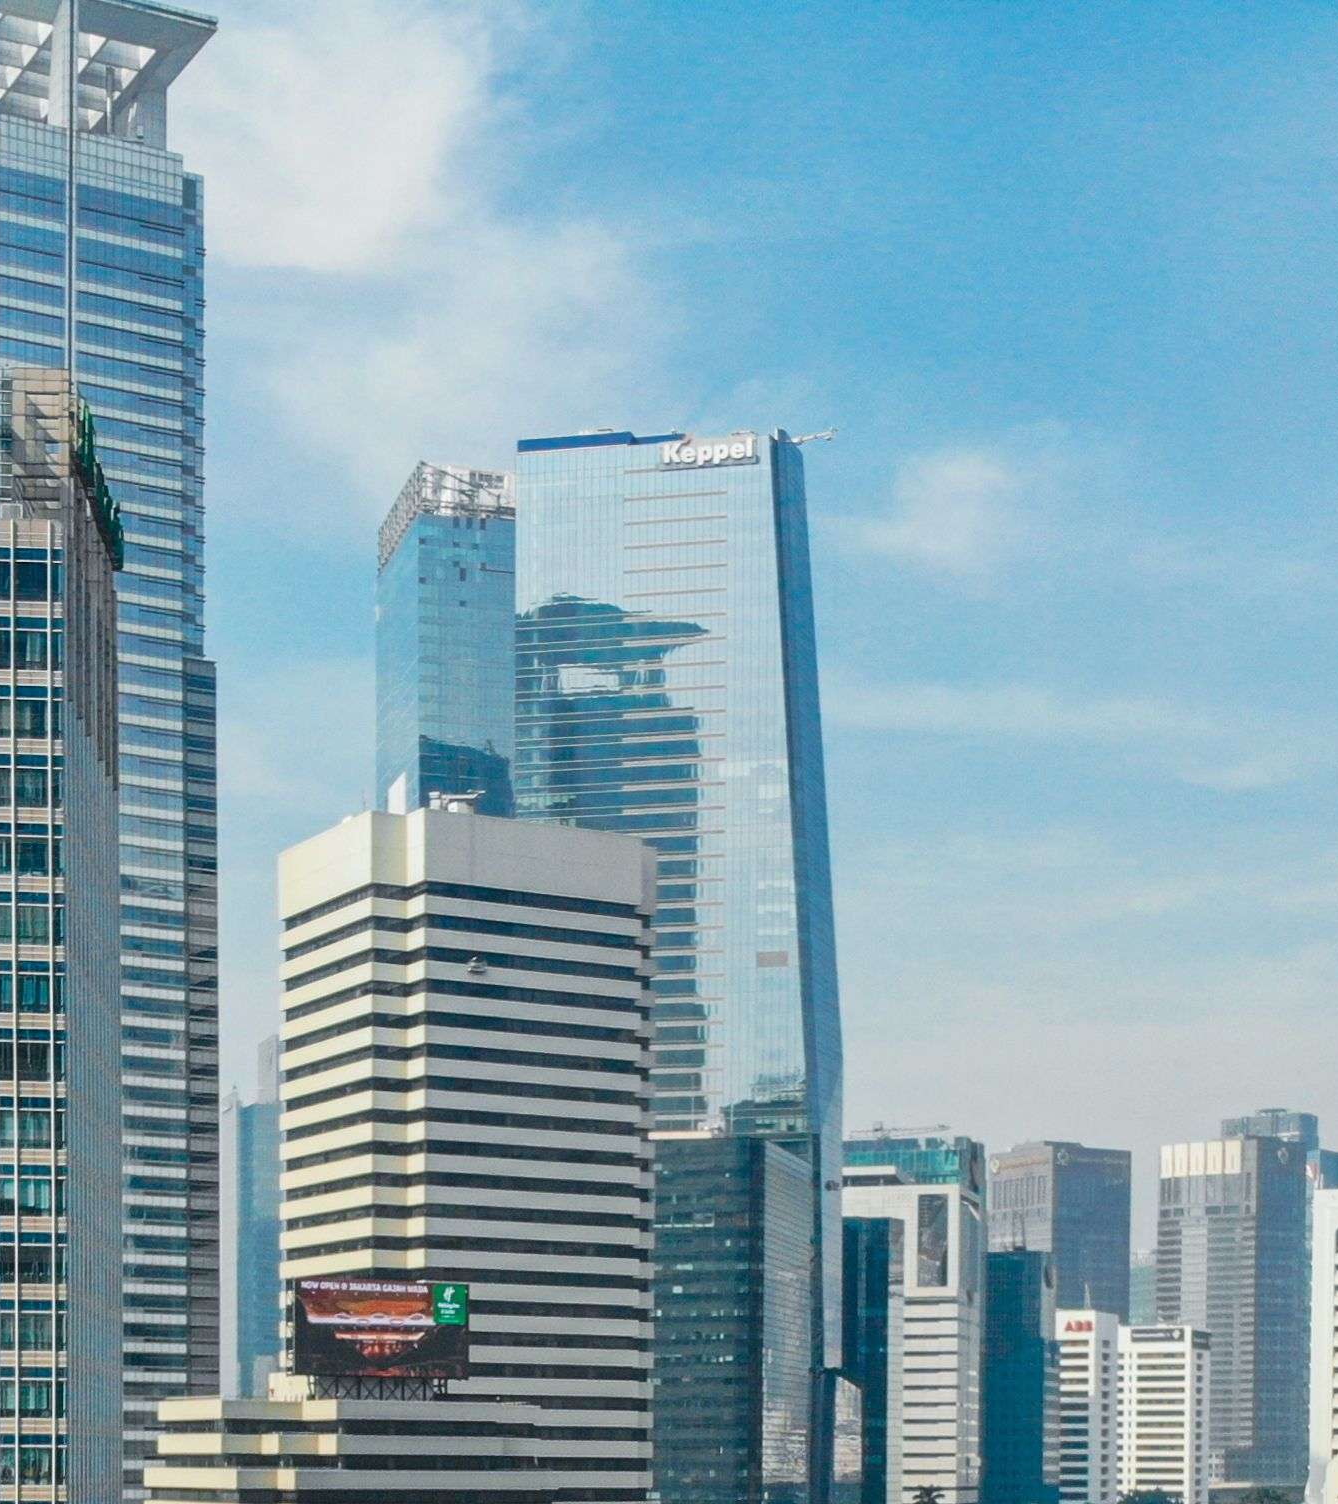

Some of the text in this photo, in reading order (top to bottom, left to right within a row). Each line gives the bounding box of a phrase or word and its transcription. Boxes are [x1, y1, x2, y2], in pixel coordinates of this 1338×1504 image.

[663, 437, 755, 465] Keppel
[300, 1281, 317, 1289] NOW
[319, 1281, 339, 1290] OPEN
[349, 1282, 381, 1292] JAKARTA
[1065, 1320, 1093, 1332] ABB
